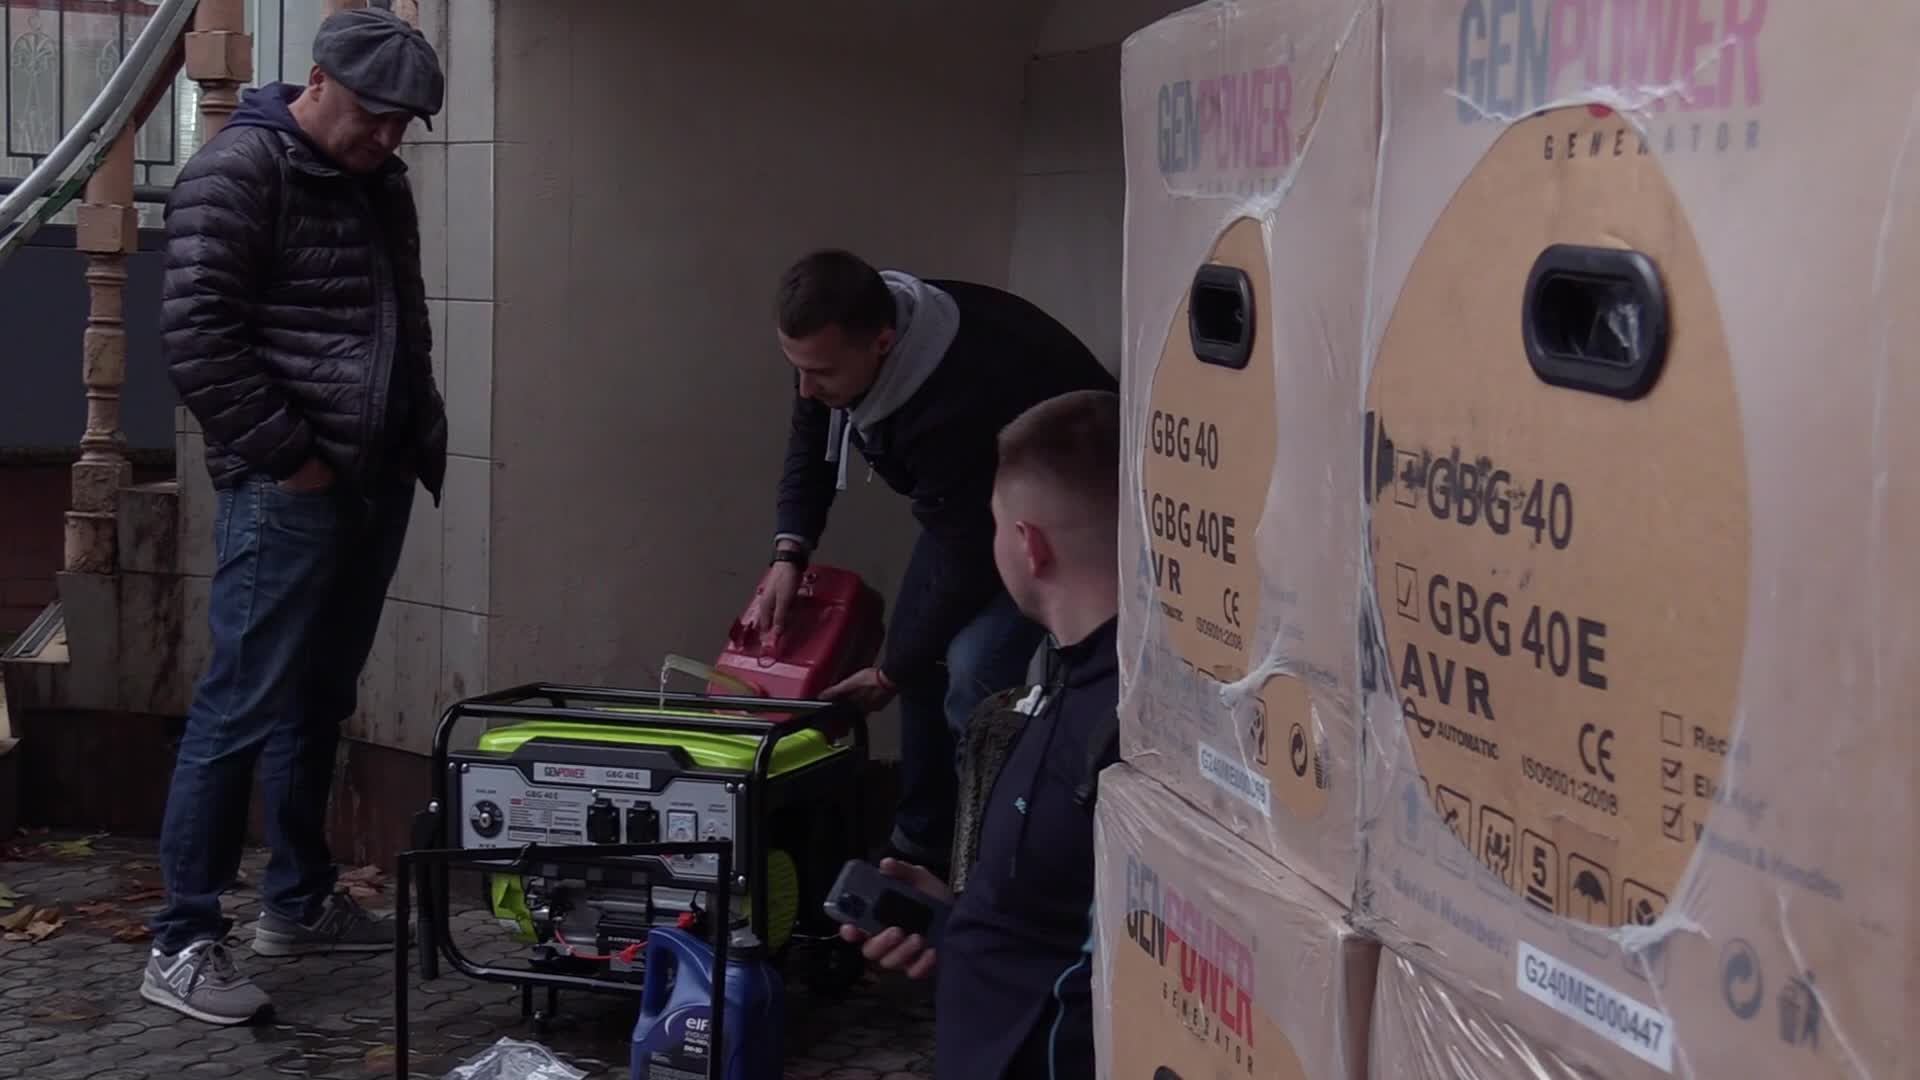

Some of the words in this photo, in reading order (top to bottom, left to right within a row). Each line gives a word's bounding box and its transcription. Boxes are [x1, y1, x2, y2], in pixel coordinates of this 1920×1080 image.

[1457, 0, 1766, 124] GENPOWER
[1158, 64, 1293, 177] GENPOWER
[1151, 410, 1190, 463] GBG
[1195, 422, 1219, 470] 40
[1151, 492, 1192, 548] GBG
[1196, 508, 1237, 565] 40E
[1426, 457, 1512, 535] GBG
[1521, 477, 1574, 550] 40
[1428, 573, 1512, 657] GBG
[1521, 604, 1609, 690] 40E
[1400, 642, 1496, 721] AVR
[1437, 720, 1500, 761] AUTOMATIC
[1521, 754, 1619, 817] ISO9001:2008
[686, 1017, 709, 1031] elf
[1525, 954, 1665, 1051] G240ME000447
